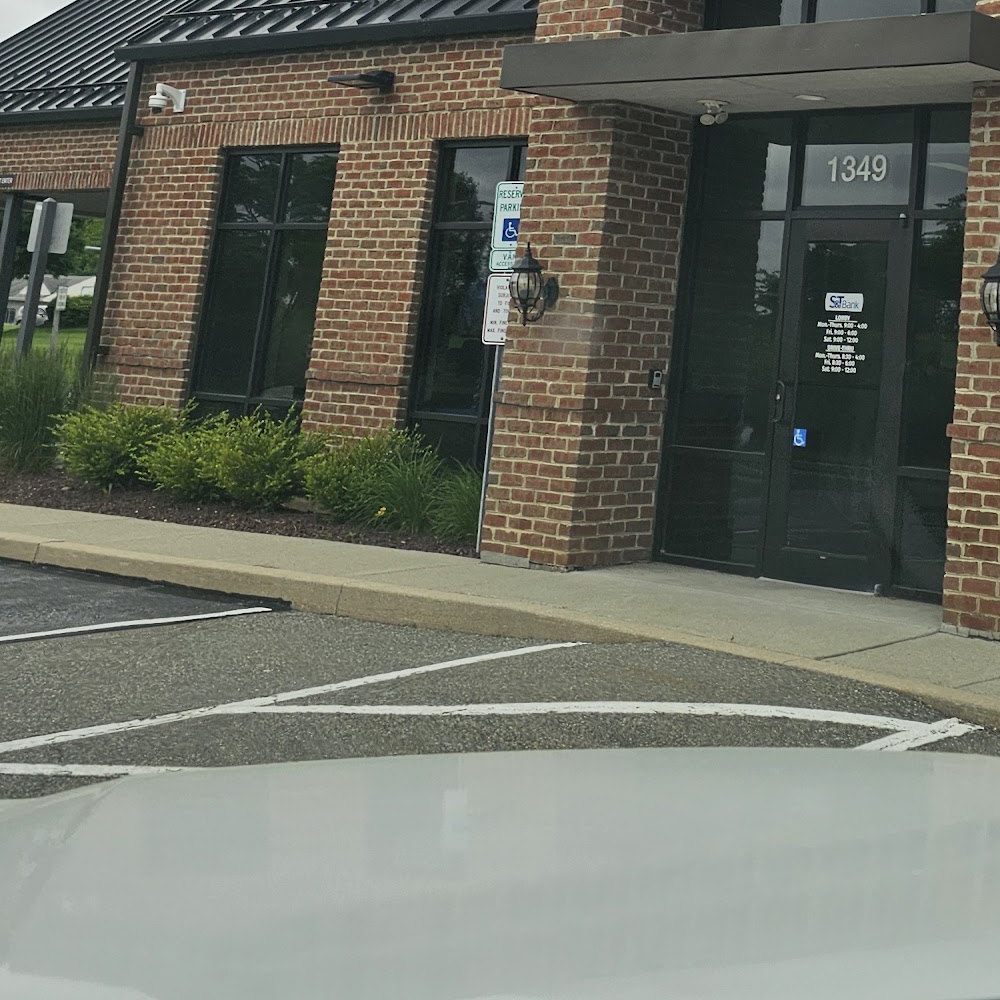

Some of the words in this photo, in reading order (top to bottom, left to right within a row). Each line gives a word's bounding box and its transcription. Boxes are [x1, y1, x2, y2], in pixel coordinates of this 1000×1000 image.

[827, 154, 887, 182] 1349
[499, 190, 523, 198] RESERV
[500, 203, 520, 211] PARKI
[829, 295, 844, 309] S&T
[842, 300, 859, 309] Bank
